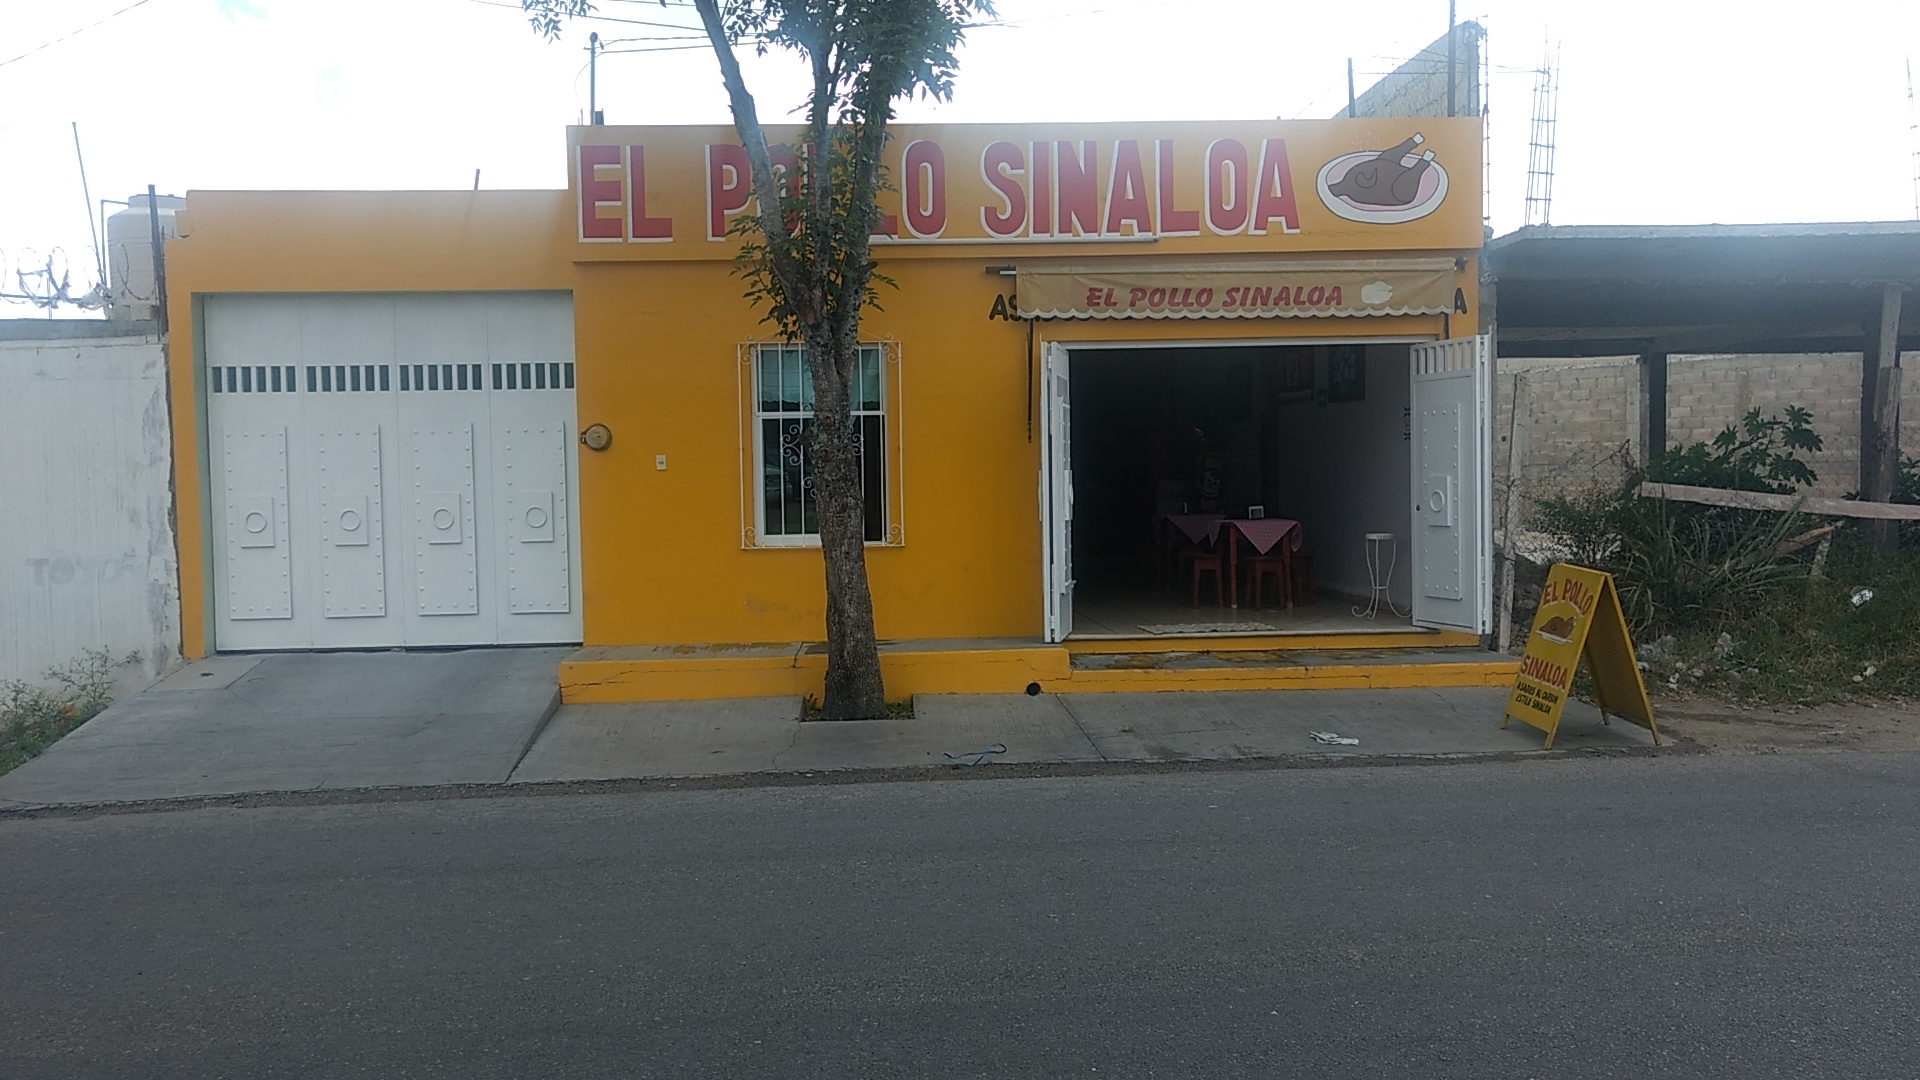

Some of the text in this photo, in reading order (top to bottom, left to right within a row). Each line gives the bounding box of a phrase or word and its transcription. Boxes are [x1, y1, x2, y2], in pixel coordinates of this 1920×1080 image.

[576, 145, 673, 243] EL
[980, 138, 1301, 238] SINALOA
[1086, 287, 1118, 308] EL
[1129, 287, 1213, 309] POLLO
[1222, 285, 1343, 308] SINALOA
[1543, 578, 1594, 617] EL POLLO
[1520, 654, 1568, 691] SINALOA
